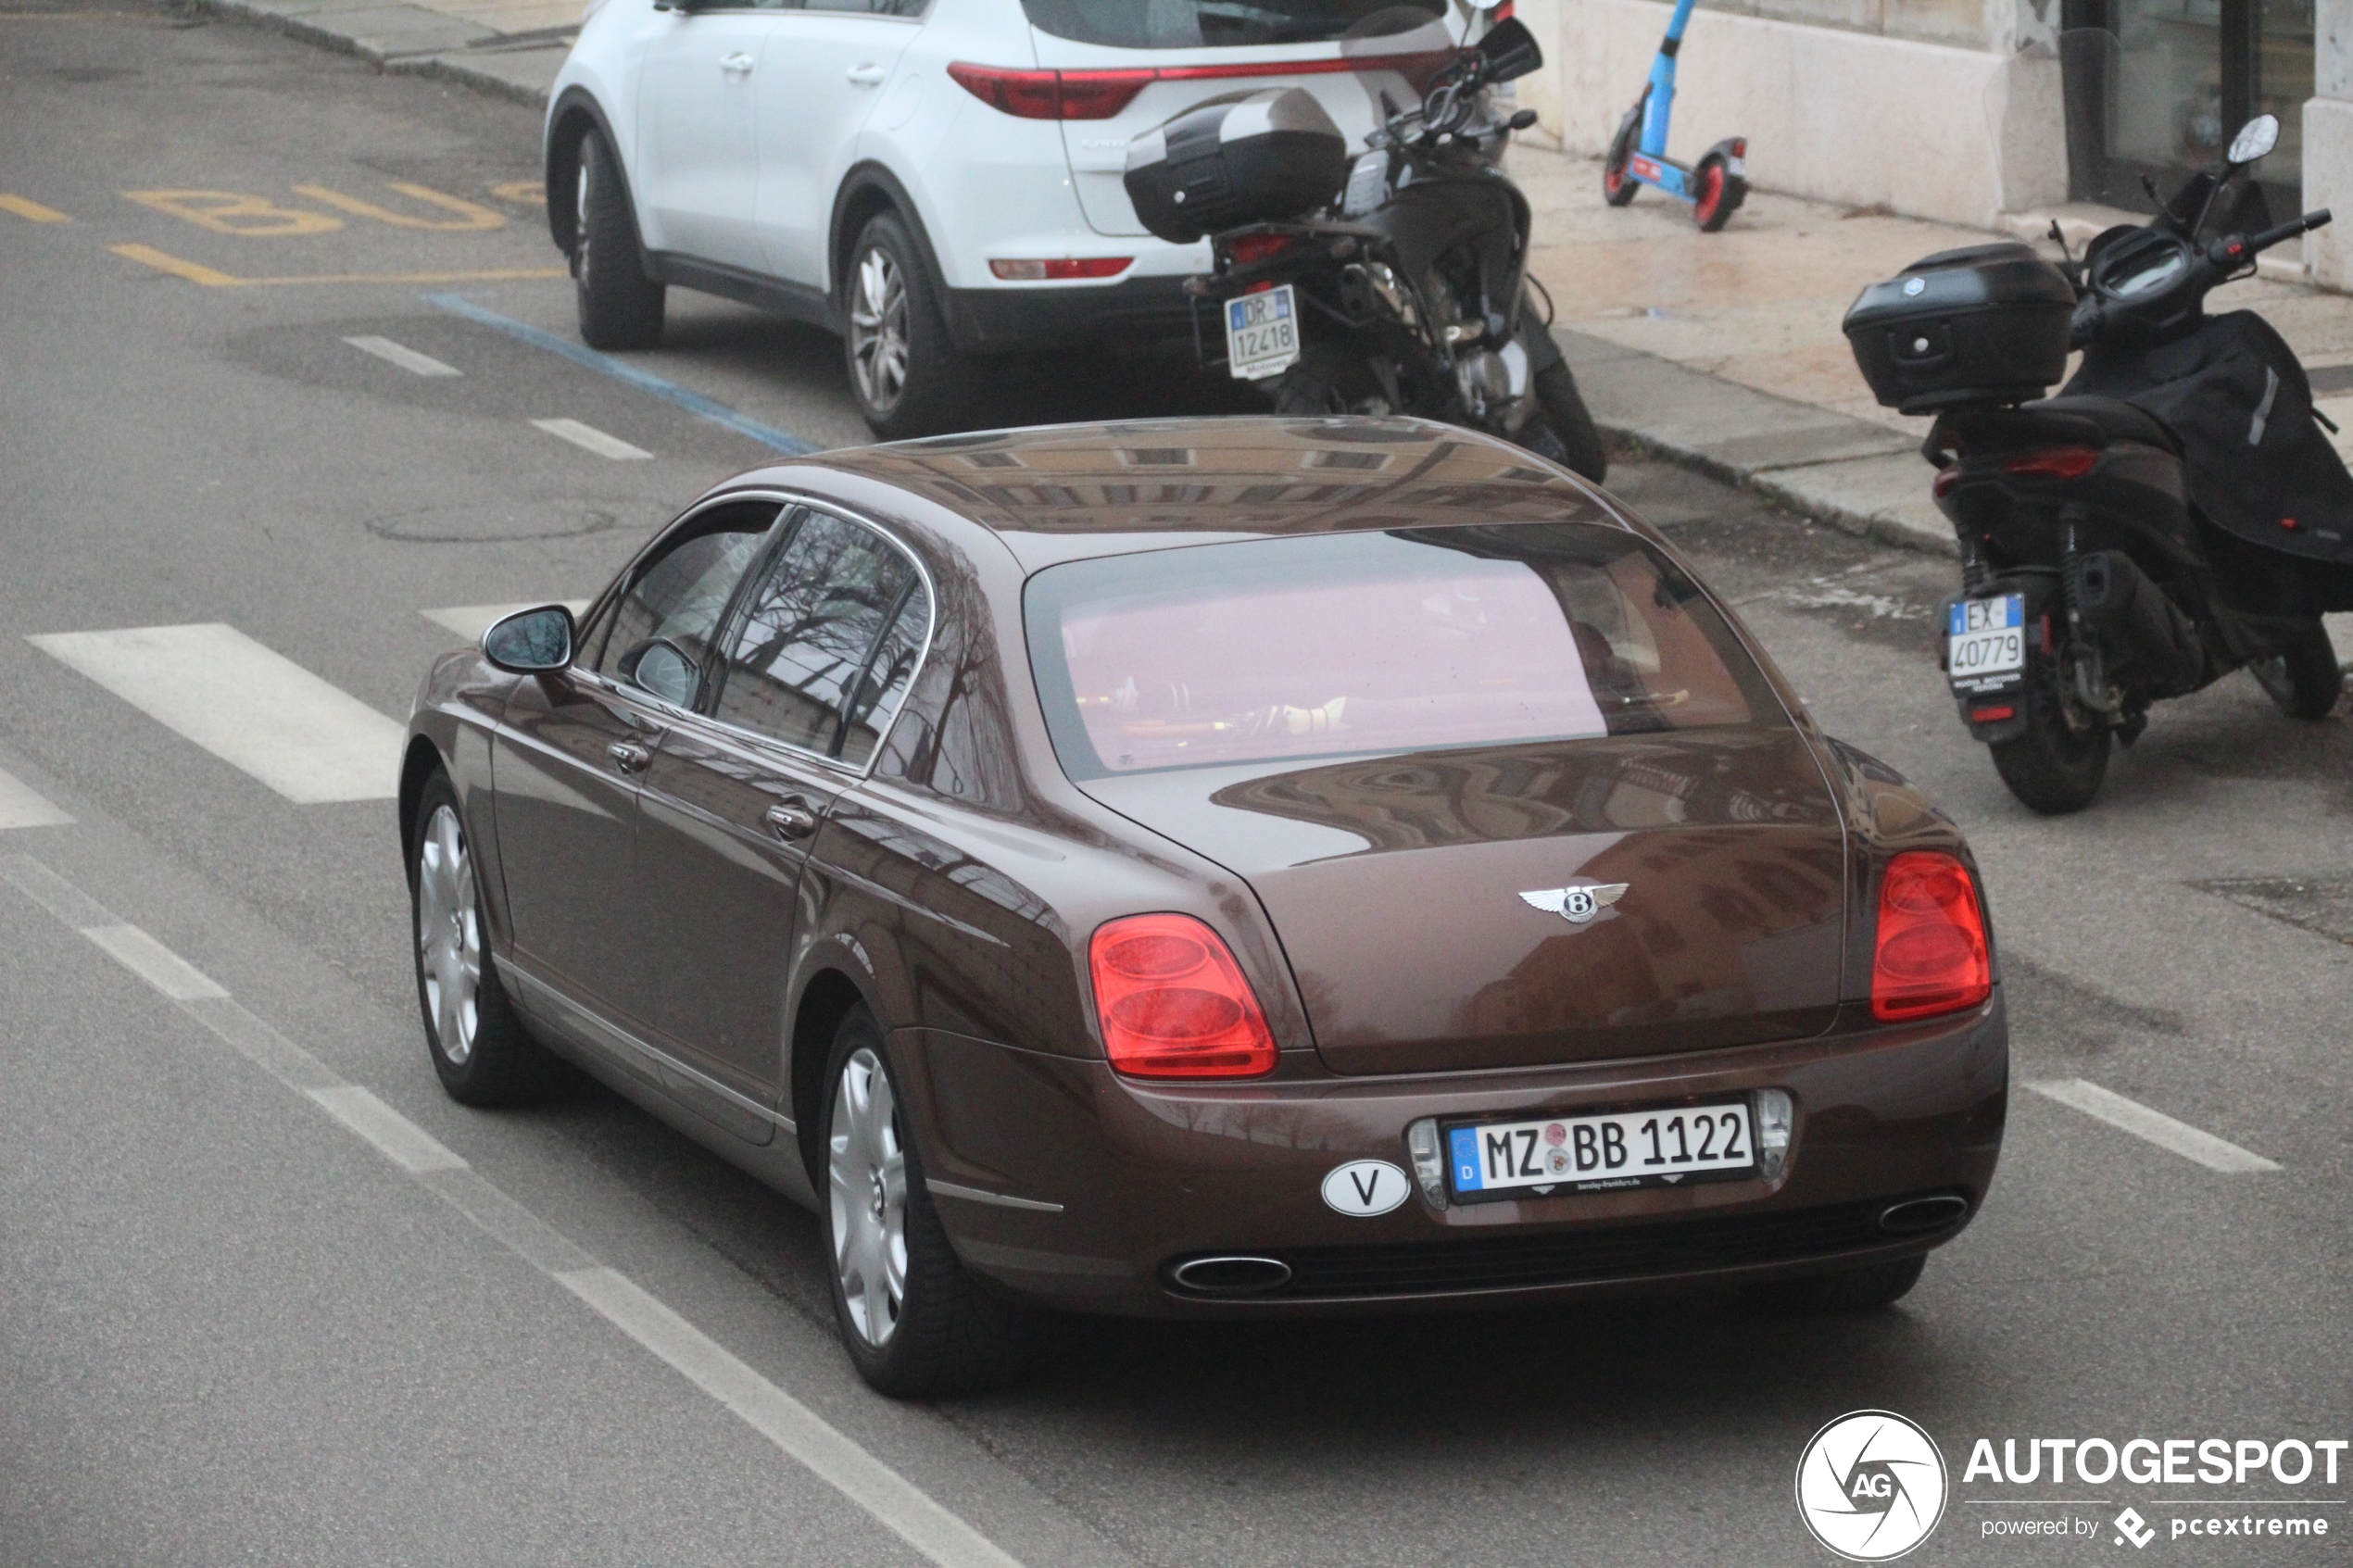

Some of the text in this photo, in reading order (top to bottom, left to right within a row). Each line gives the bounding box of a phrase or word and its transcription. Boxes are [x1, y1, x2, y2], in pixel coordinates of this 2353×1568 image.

[1245, 297, 1266, 326] DR
[1238, 324, 1291, 358] 12418
[1968, 600, 1994, 631] EX
[1955, 635, 2019, 668] 40779
[1972, 683, 2004, 692] VERONA
[1567, 893, 1590, 913] B
[1486, 1112, 1745, 1179] MZ BB 1122
[1350, 1169, 1379, 1206] V
[1462, 1165, 1473, 1180] D
